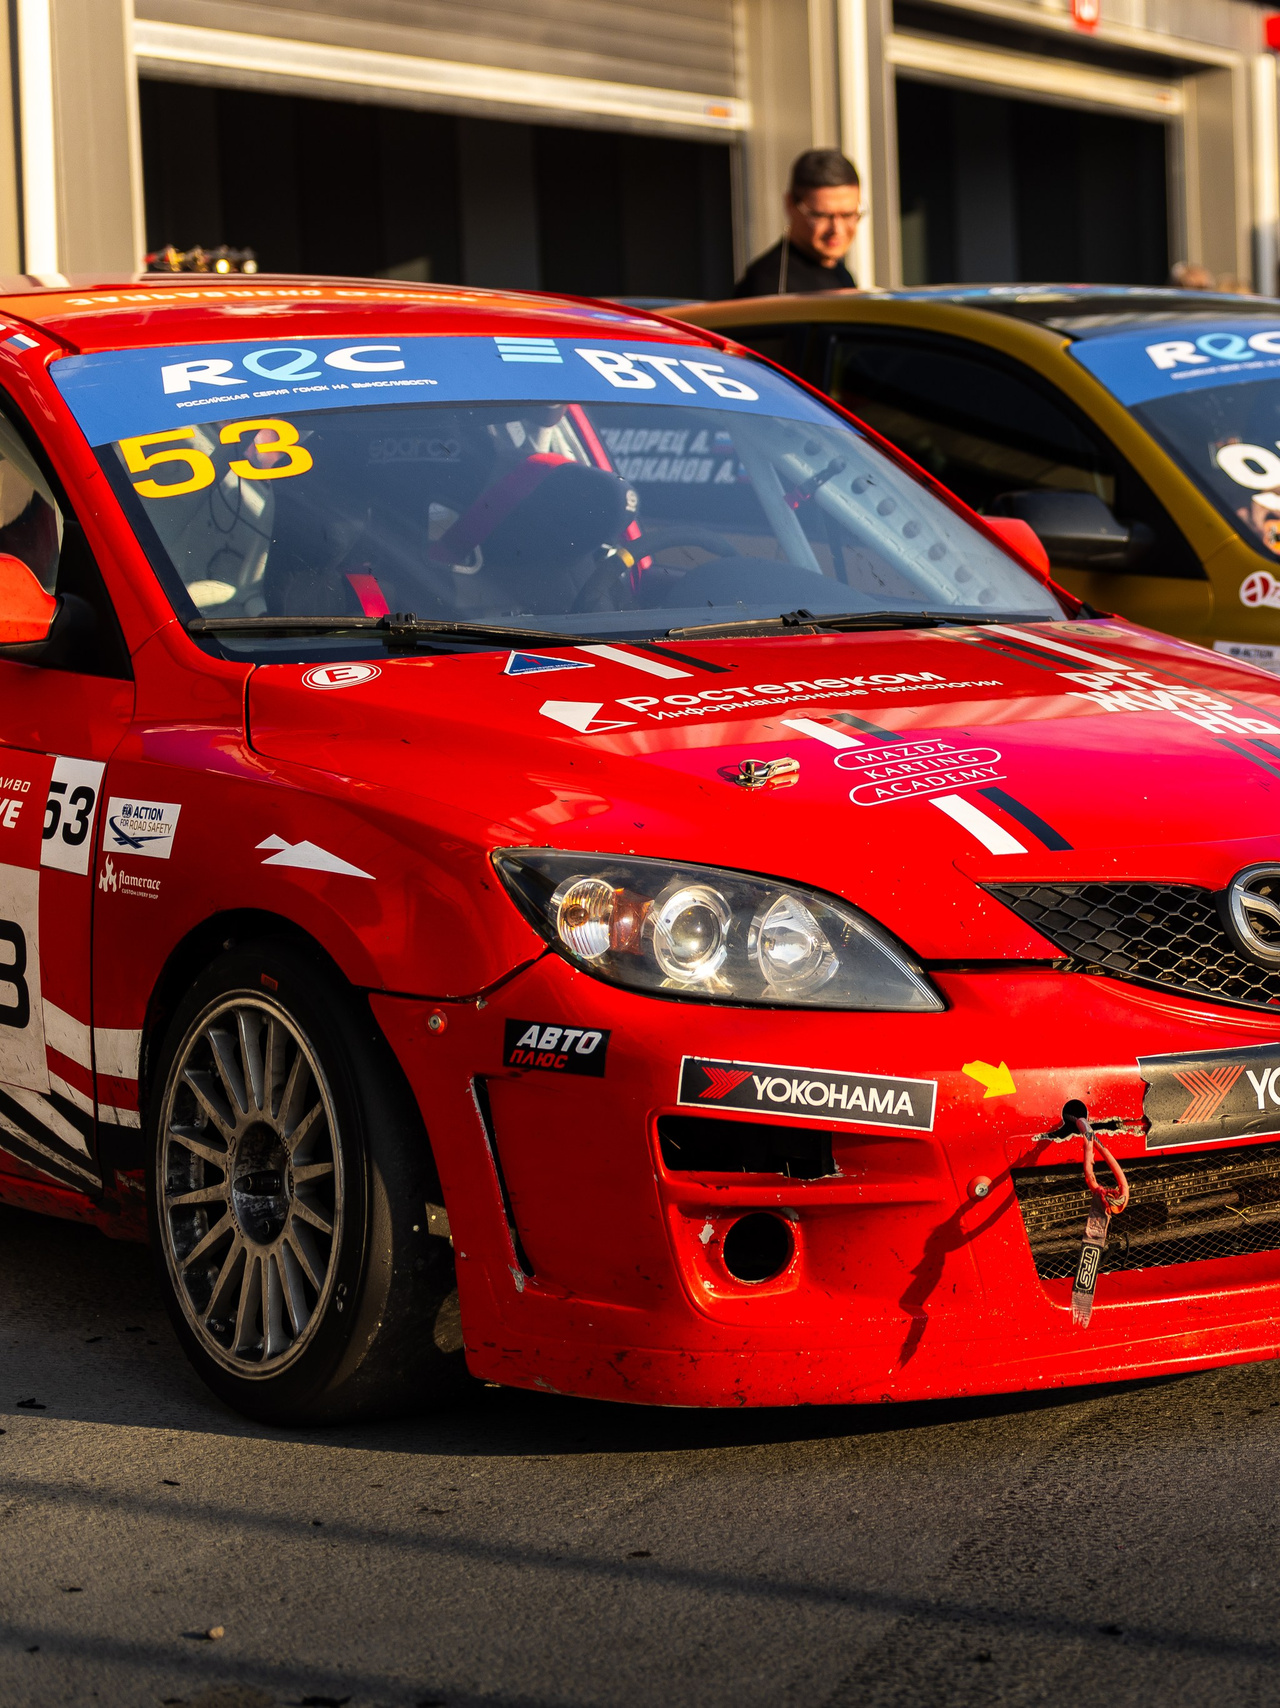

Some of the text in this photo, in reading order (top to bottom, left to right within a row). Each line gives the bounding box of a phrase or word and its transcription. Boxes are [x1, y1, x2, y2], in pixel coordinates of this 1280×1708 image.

[574, 347, 759, 402] ВТБ
[175, 379, 439, 409] РОССИЙСКАЯ СЕРИЯ ГОНОК НА ВЫНОСЛИВОСТЬ
[117, 418, 314, 500] 53
[614, 671, 947, 713] Ростелеком
[647, 679, 1004, 721] Информационные технологии
[855, 740, 956, 764] MAZDA
[863, 753, 979, 779] KARTING
[875, 766, 999, 798] ACADEMY
[42, 780, 96, 846] 53
[120, 818, 173, 834] FOR ROAD SAFETY
[133, 806, 164, 821] ACTION
[118, 870, 161, 891] flamerace
[516, 1023, 603, 1055] АВТО
[509, 1049, 569, 1069] ПЛЮС
[752, 1074, 915, 1118] YOKOHAMA
